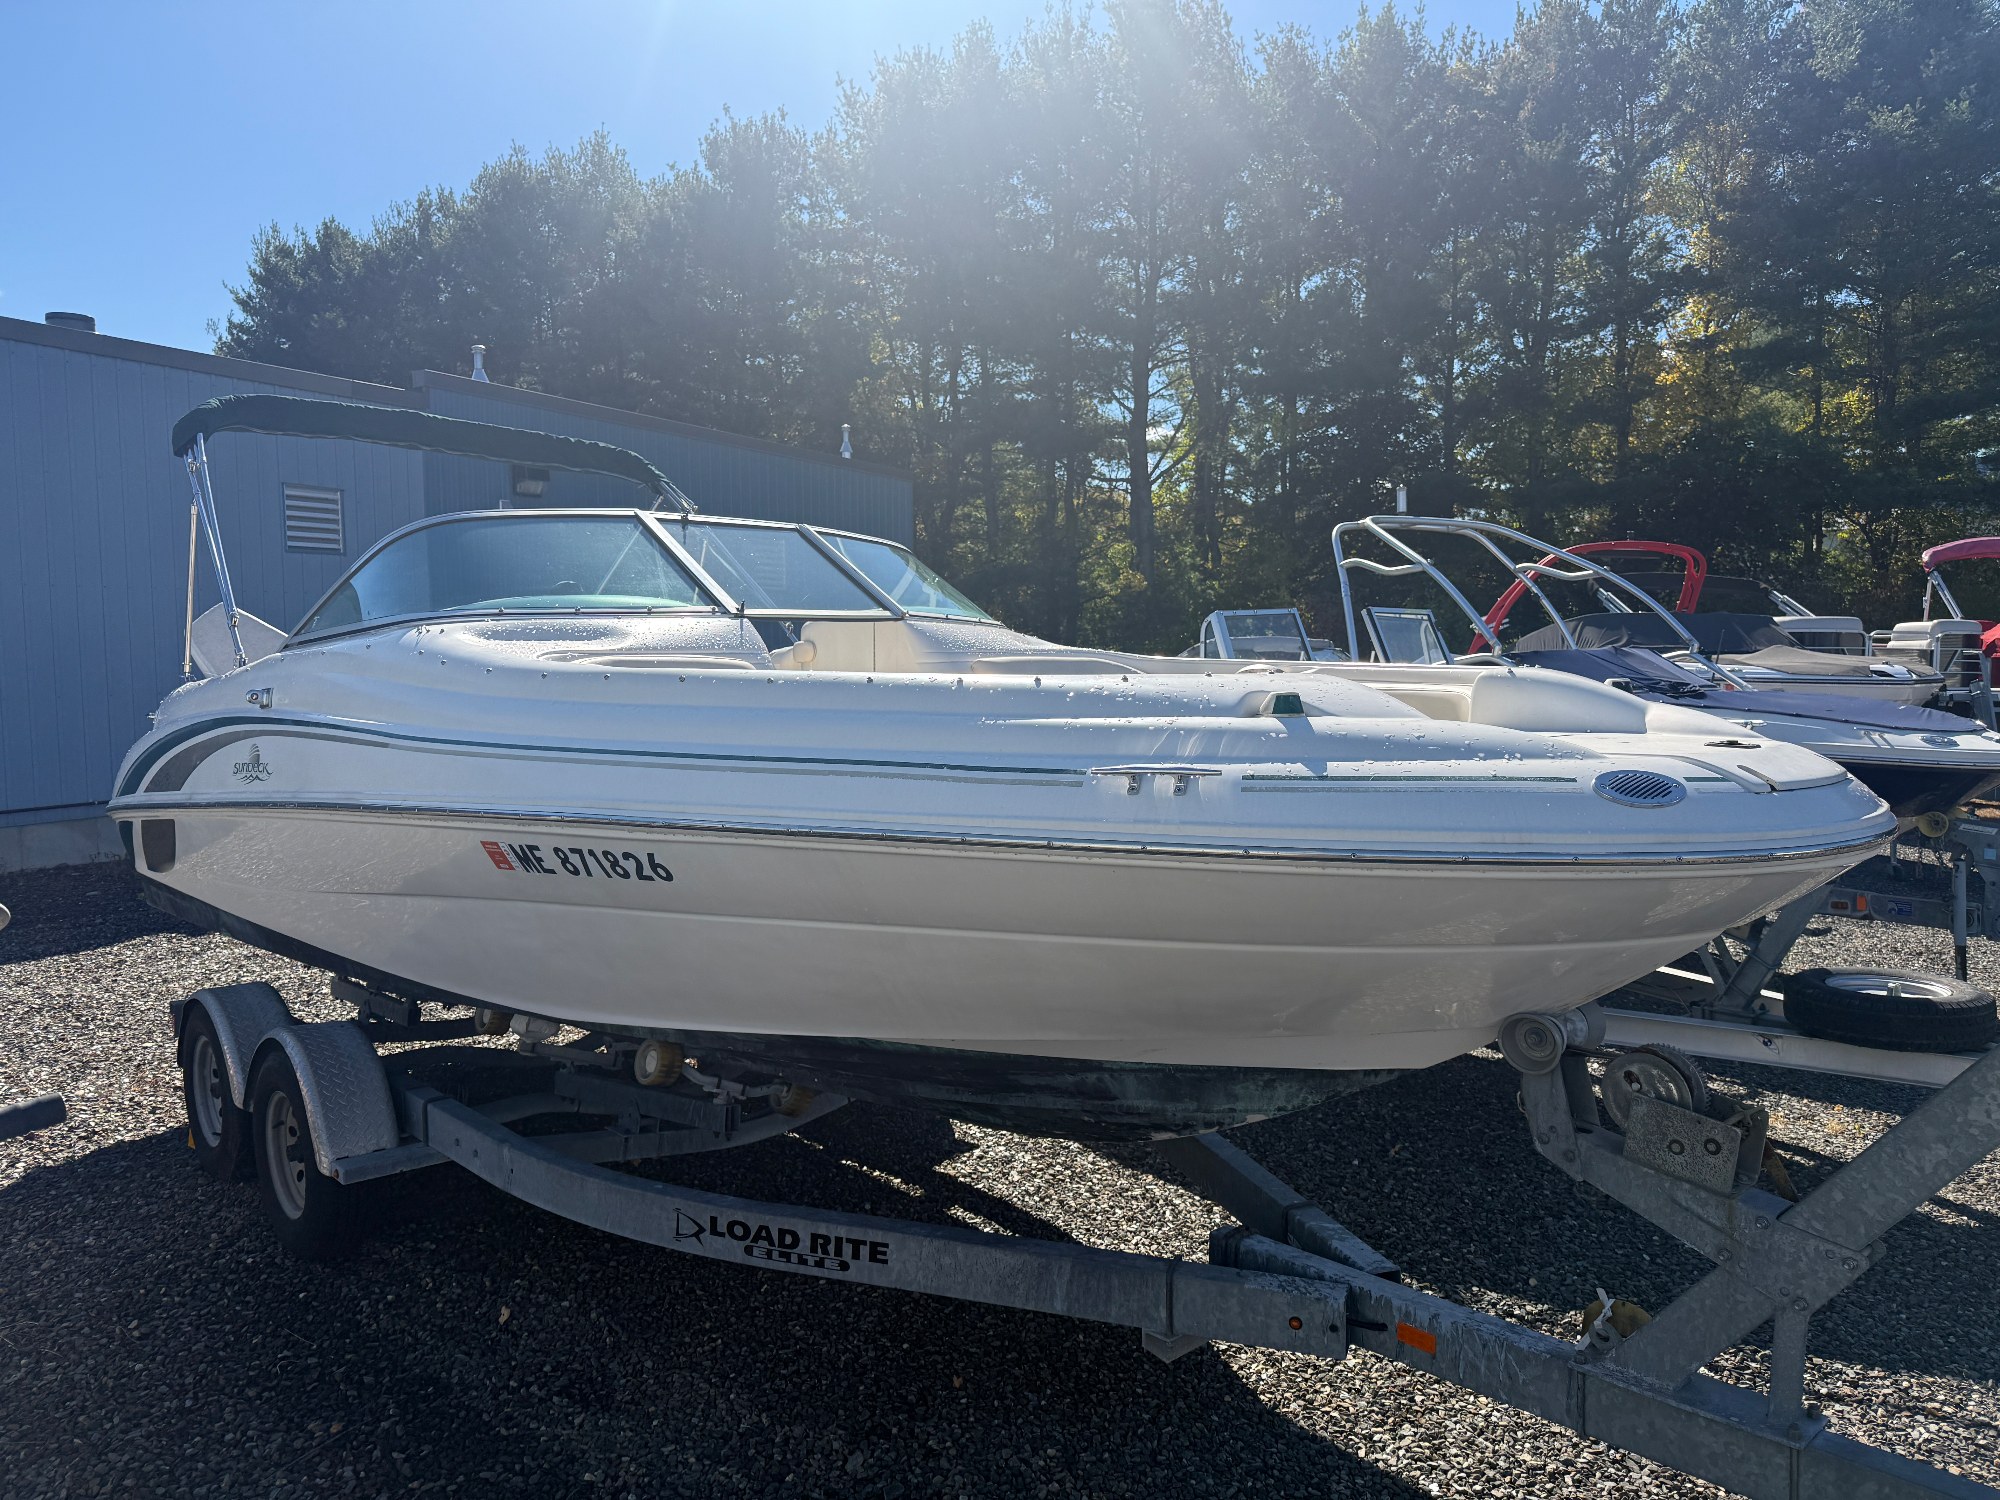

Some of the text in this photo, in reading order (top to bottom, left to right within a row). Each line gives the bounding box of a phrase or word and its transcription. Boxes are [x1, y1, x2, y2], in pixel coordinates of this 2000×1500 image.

[507, 843, 557, 875] ME
[552, 846, 674, 882] 871826
[709, 1215, 890, 1265] LOAD RITE
[752, 1246, 841, 1272] ELITE
